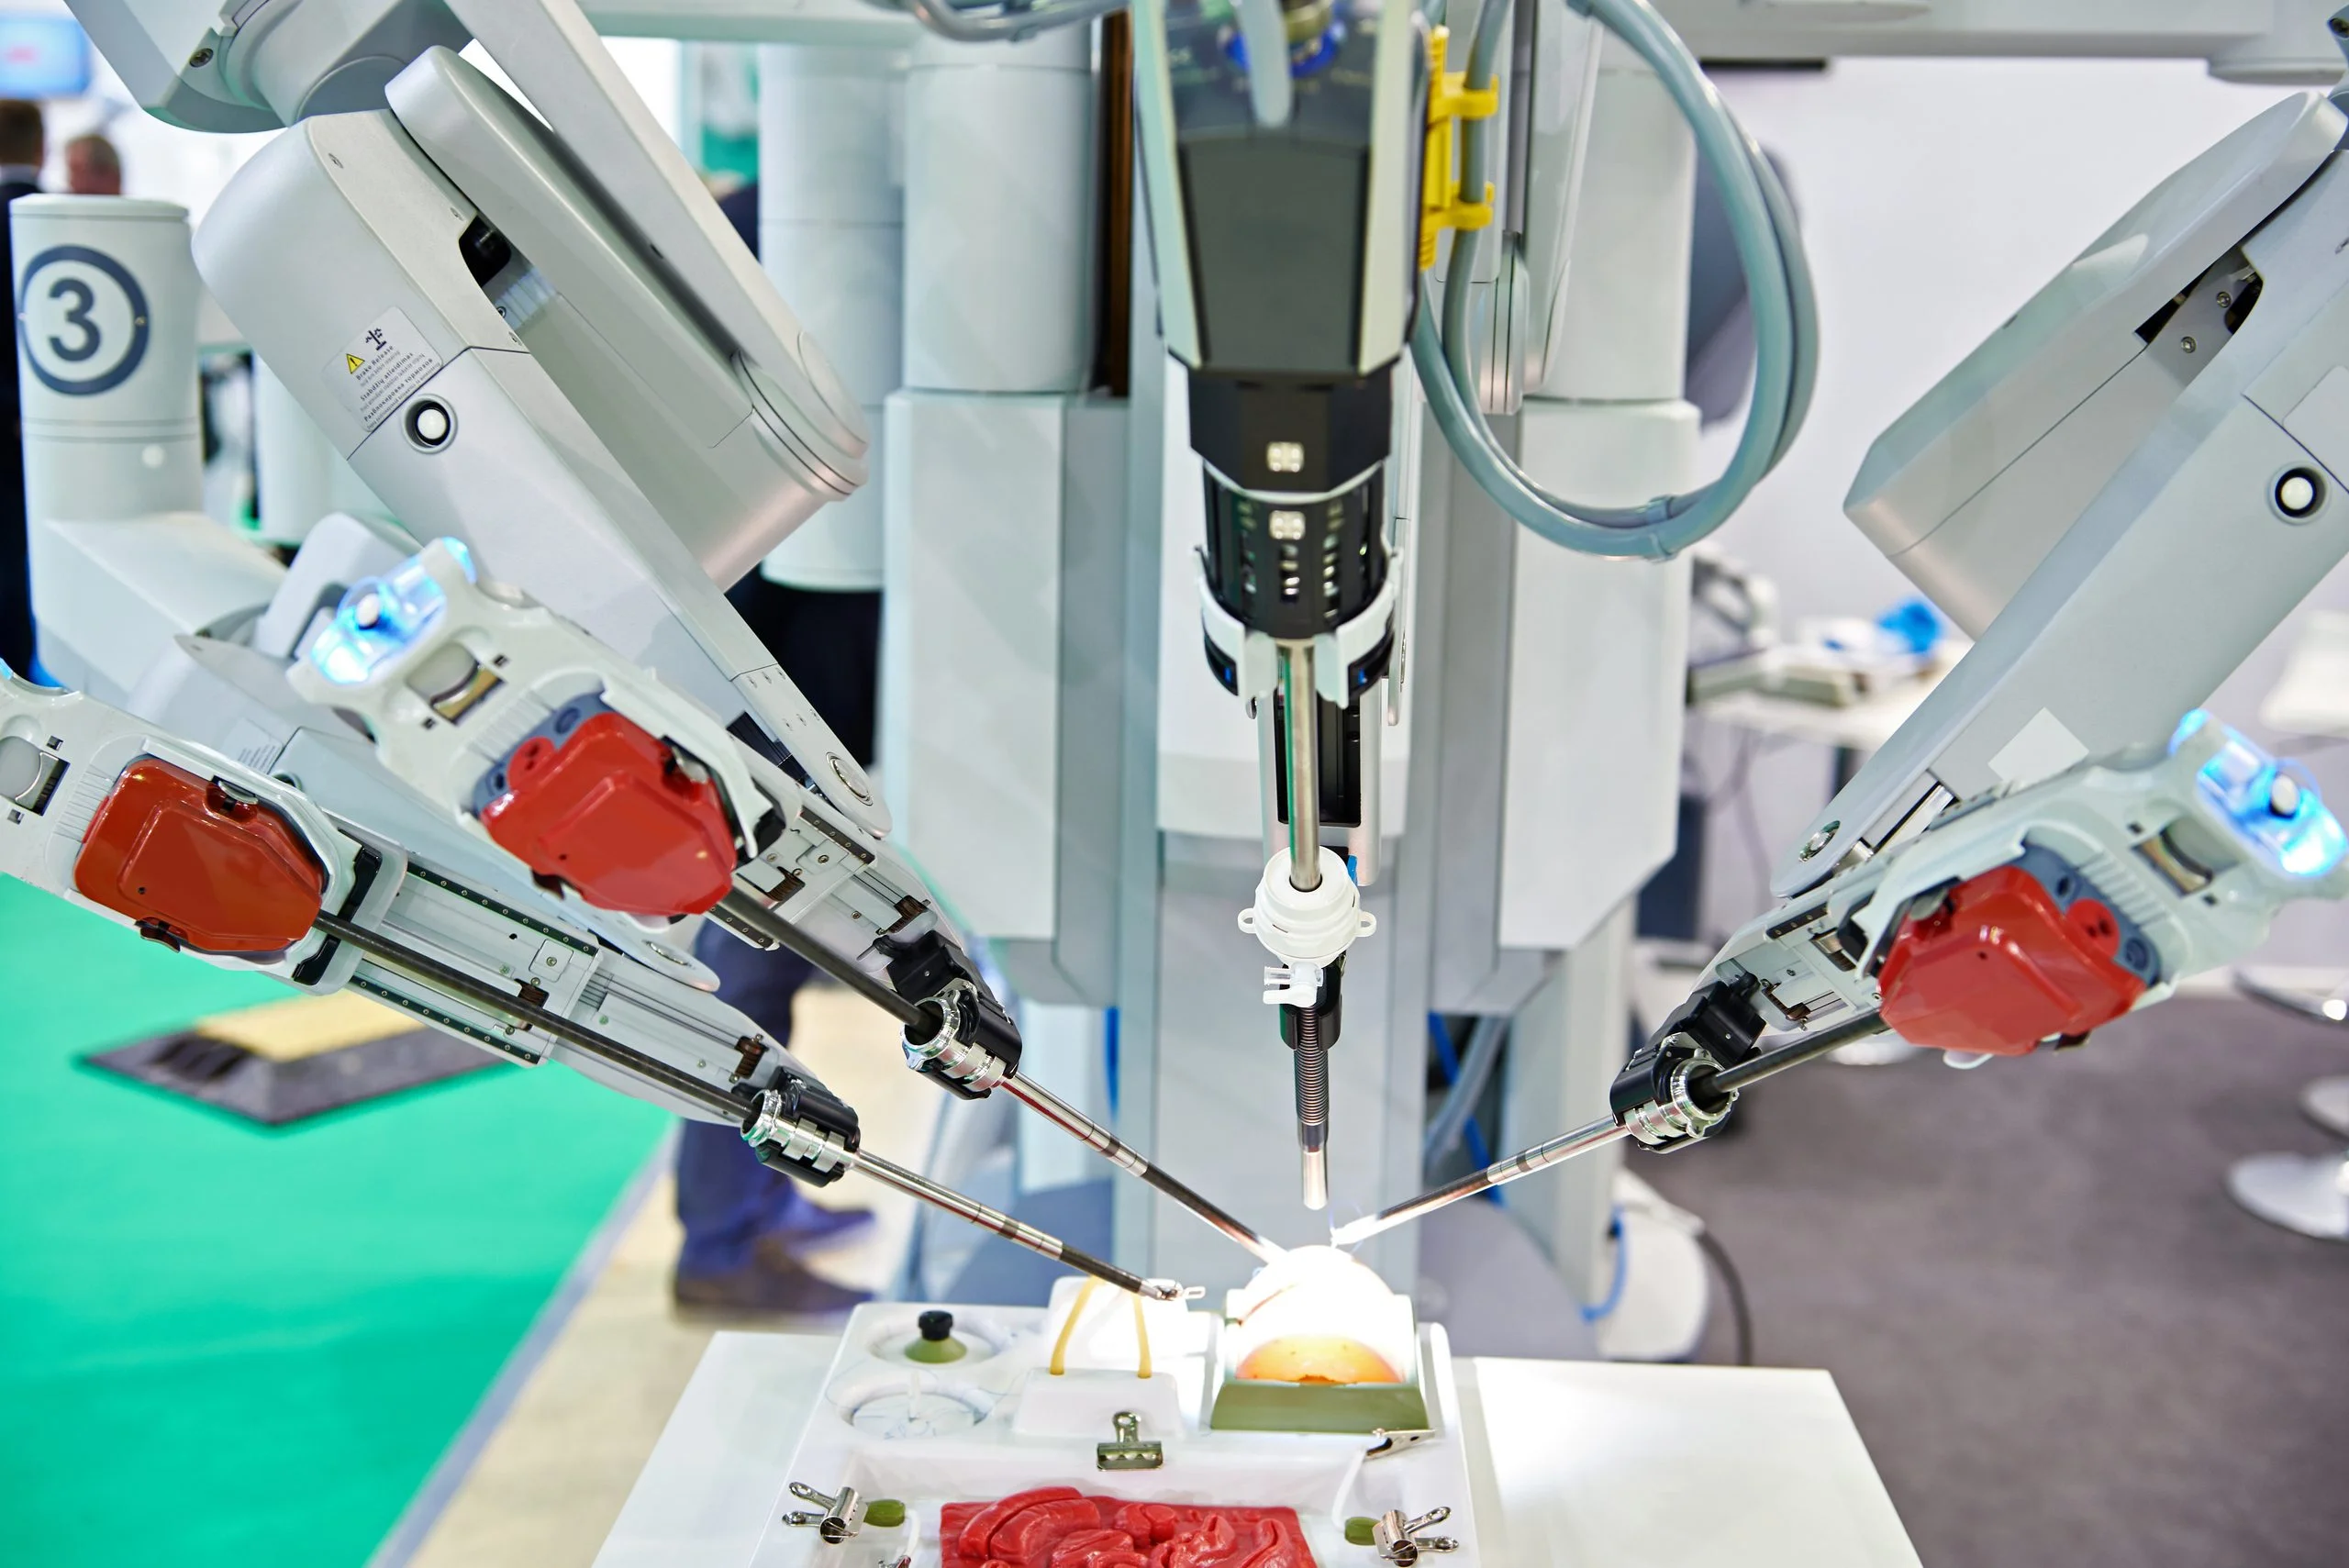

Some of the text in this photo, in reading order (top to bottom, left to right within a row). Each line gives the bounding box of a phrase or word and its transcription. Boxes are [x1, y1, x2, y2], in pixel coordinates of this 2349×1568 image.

[49, 277, 101, 361] 3
[355, 365, 372, 381] Brake
[371, 345, 394, 366] Release
